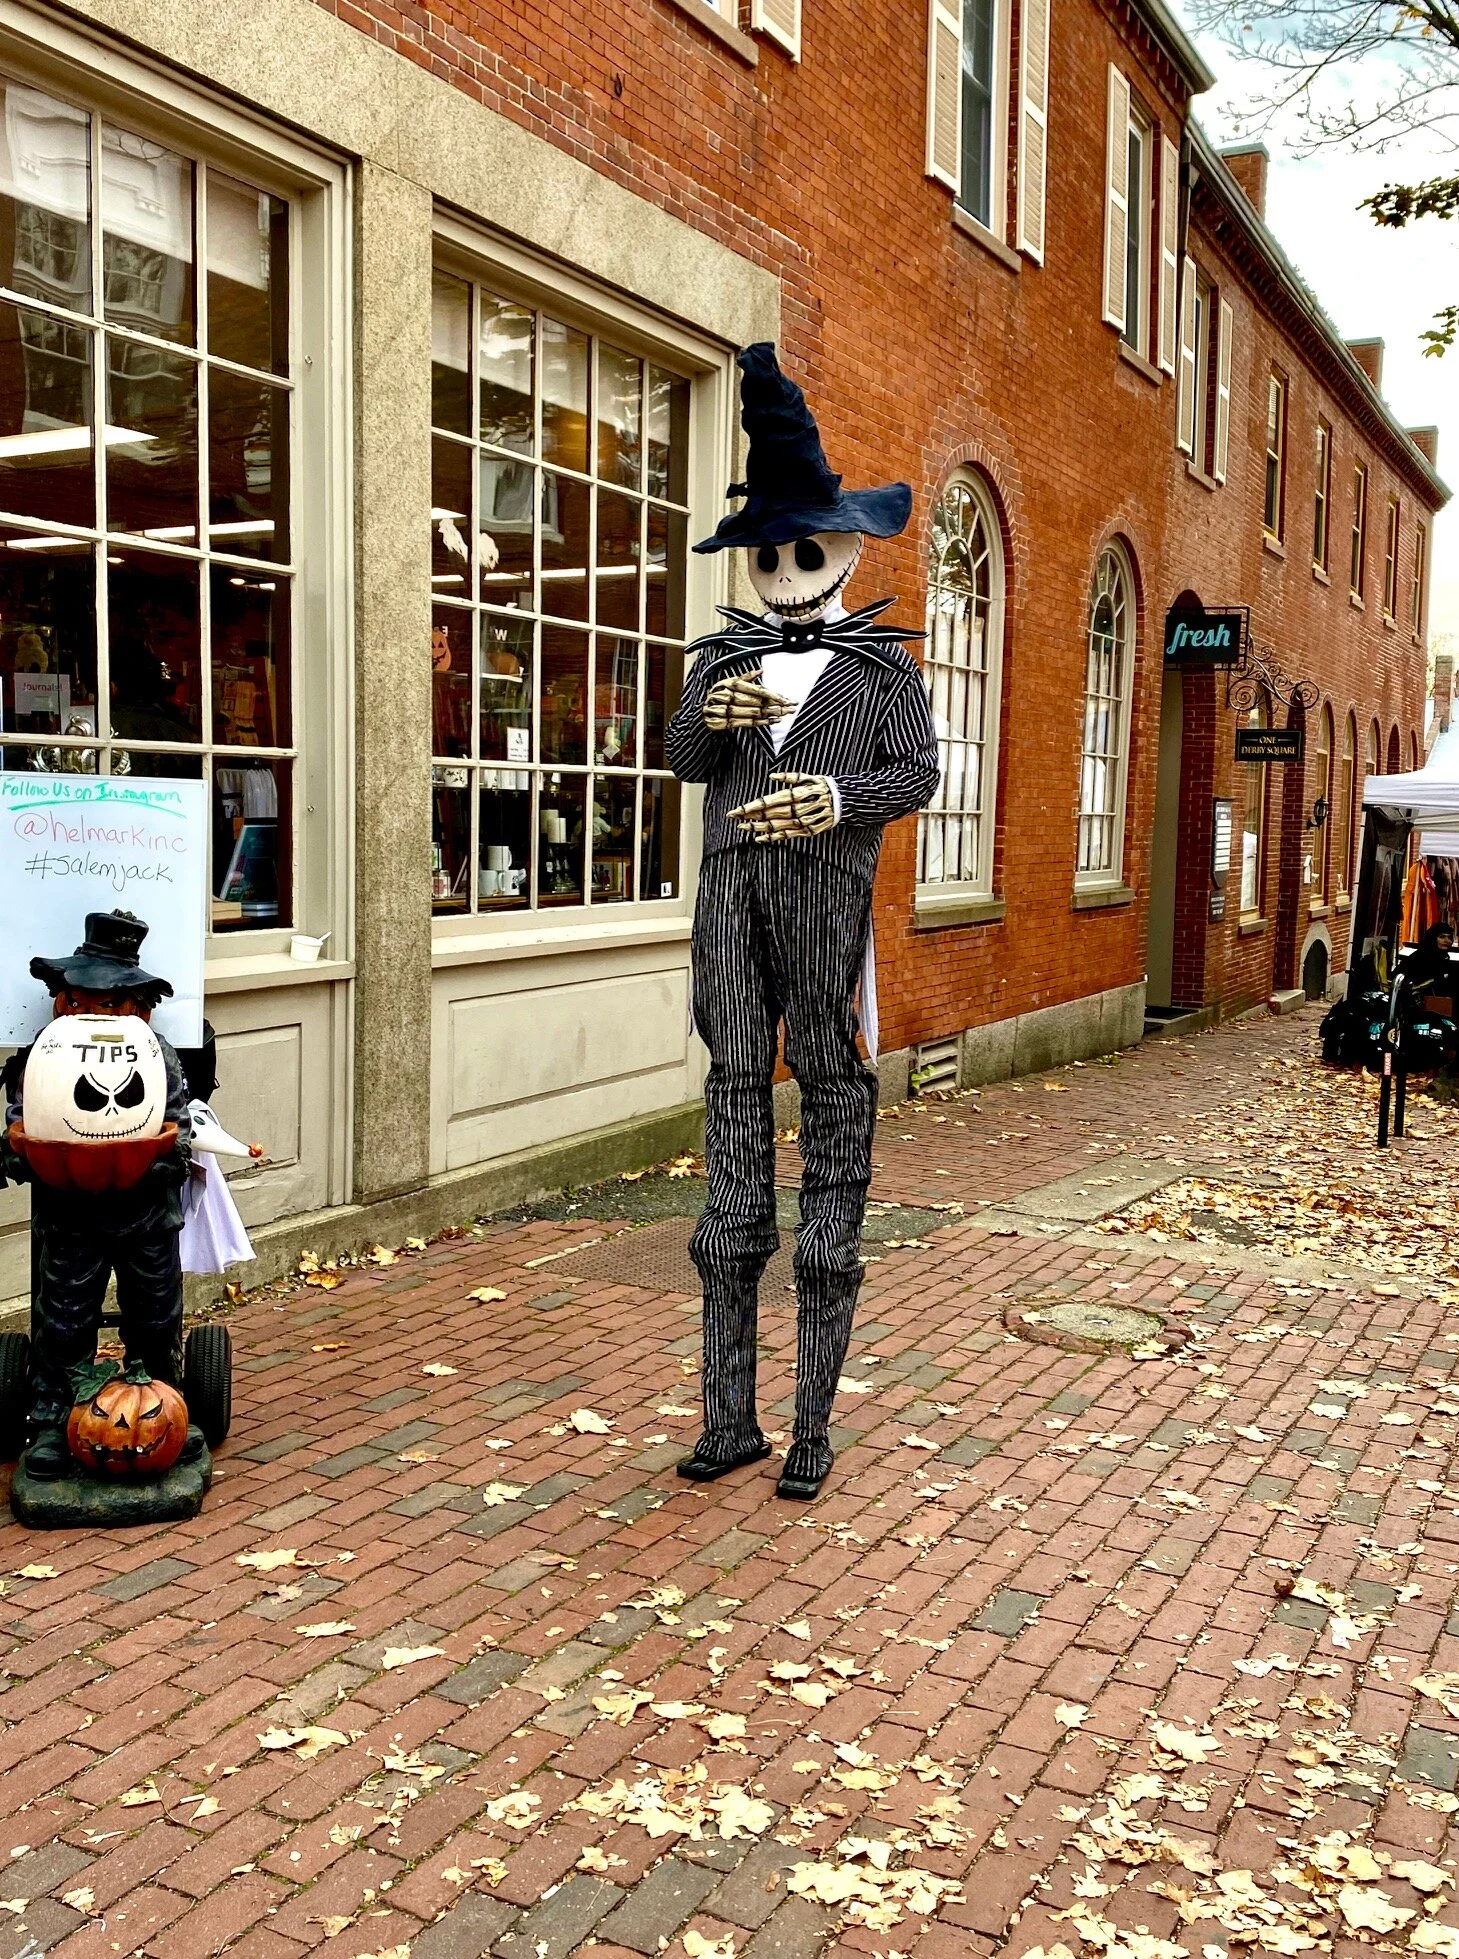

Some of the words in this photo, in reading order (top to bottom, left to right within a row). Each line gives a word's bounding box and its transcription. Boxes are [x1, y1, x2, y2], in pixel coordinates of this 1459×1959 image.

[1166, 622, 1231, 655] fresh
[1259, 736, 1277, 744] ONE
[1241, 746, 1266, 754] DERBY
[1266, 746, 1297, 756] SQUARE
[2, 777, 49, 796] Follow
[53, 782, 71, 798] Us
[75, 787, 92, 800] on
[94, 782, 182, 803] Instagram
[72, 1044, 138, 1063] TIPS
